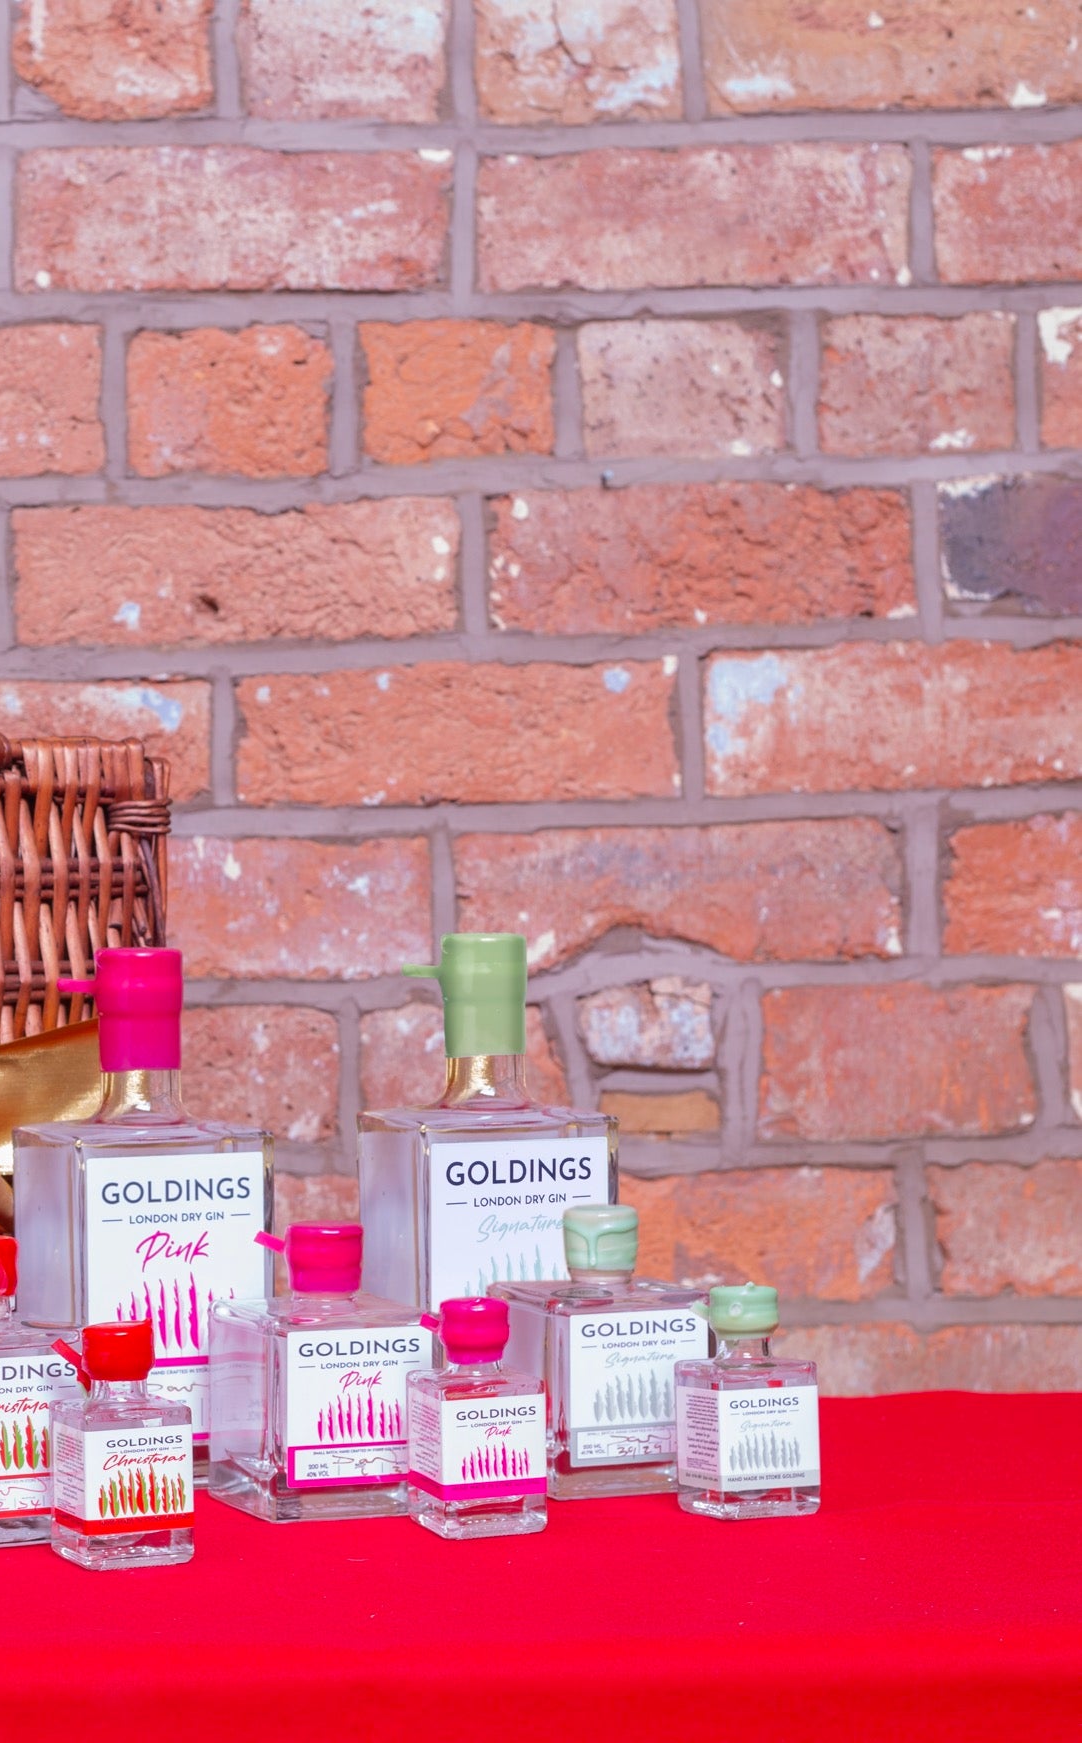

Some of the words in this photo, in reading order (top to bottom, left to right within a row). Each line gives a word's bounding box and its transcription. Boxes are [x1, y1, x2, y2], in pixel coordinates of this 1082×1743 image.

[446, 1157, 591, 1186] GOLDINGS
[102, 1177, 250, 1204] GOLDINGS
[474, 1196, 521, 1207] LONDON
[525, 1195, 545, 1204] DRY
[548, 1194, 566, 1203] GIN
[129, 1214, 178, 1224] LONDON
[182, 1213, 202, 1222] DRY
[206, 1212, 224, 1221] GIN
[477, 1214, 565, 1243] Signature
[136, 1231, 209, 1272] Pink
[582, 1318, 696, 1337] GOLDINGS
[299, 1338, 419, 1357] GOLDINGS
[604, 1352, 677, 1368] Signature
[339, 1371, 382, 1393] Pink
[730, 1397, 798, 1409] GOLDINGS
[456, 1406, 536, 1421] GOLDINGS
[485, 1426, 512, 1439] Pink
[106, 1435, 182, 1448] GOLDINGS
[103, 1454, 186, 1470] Christmas
